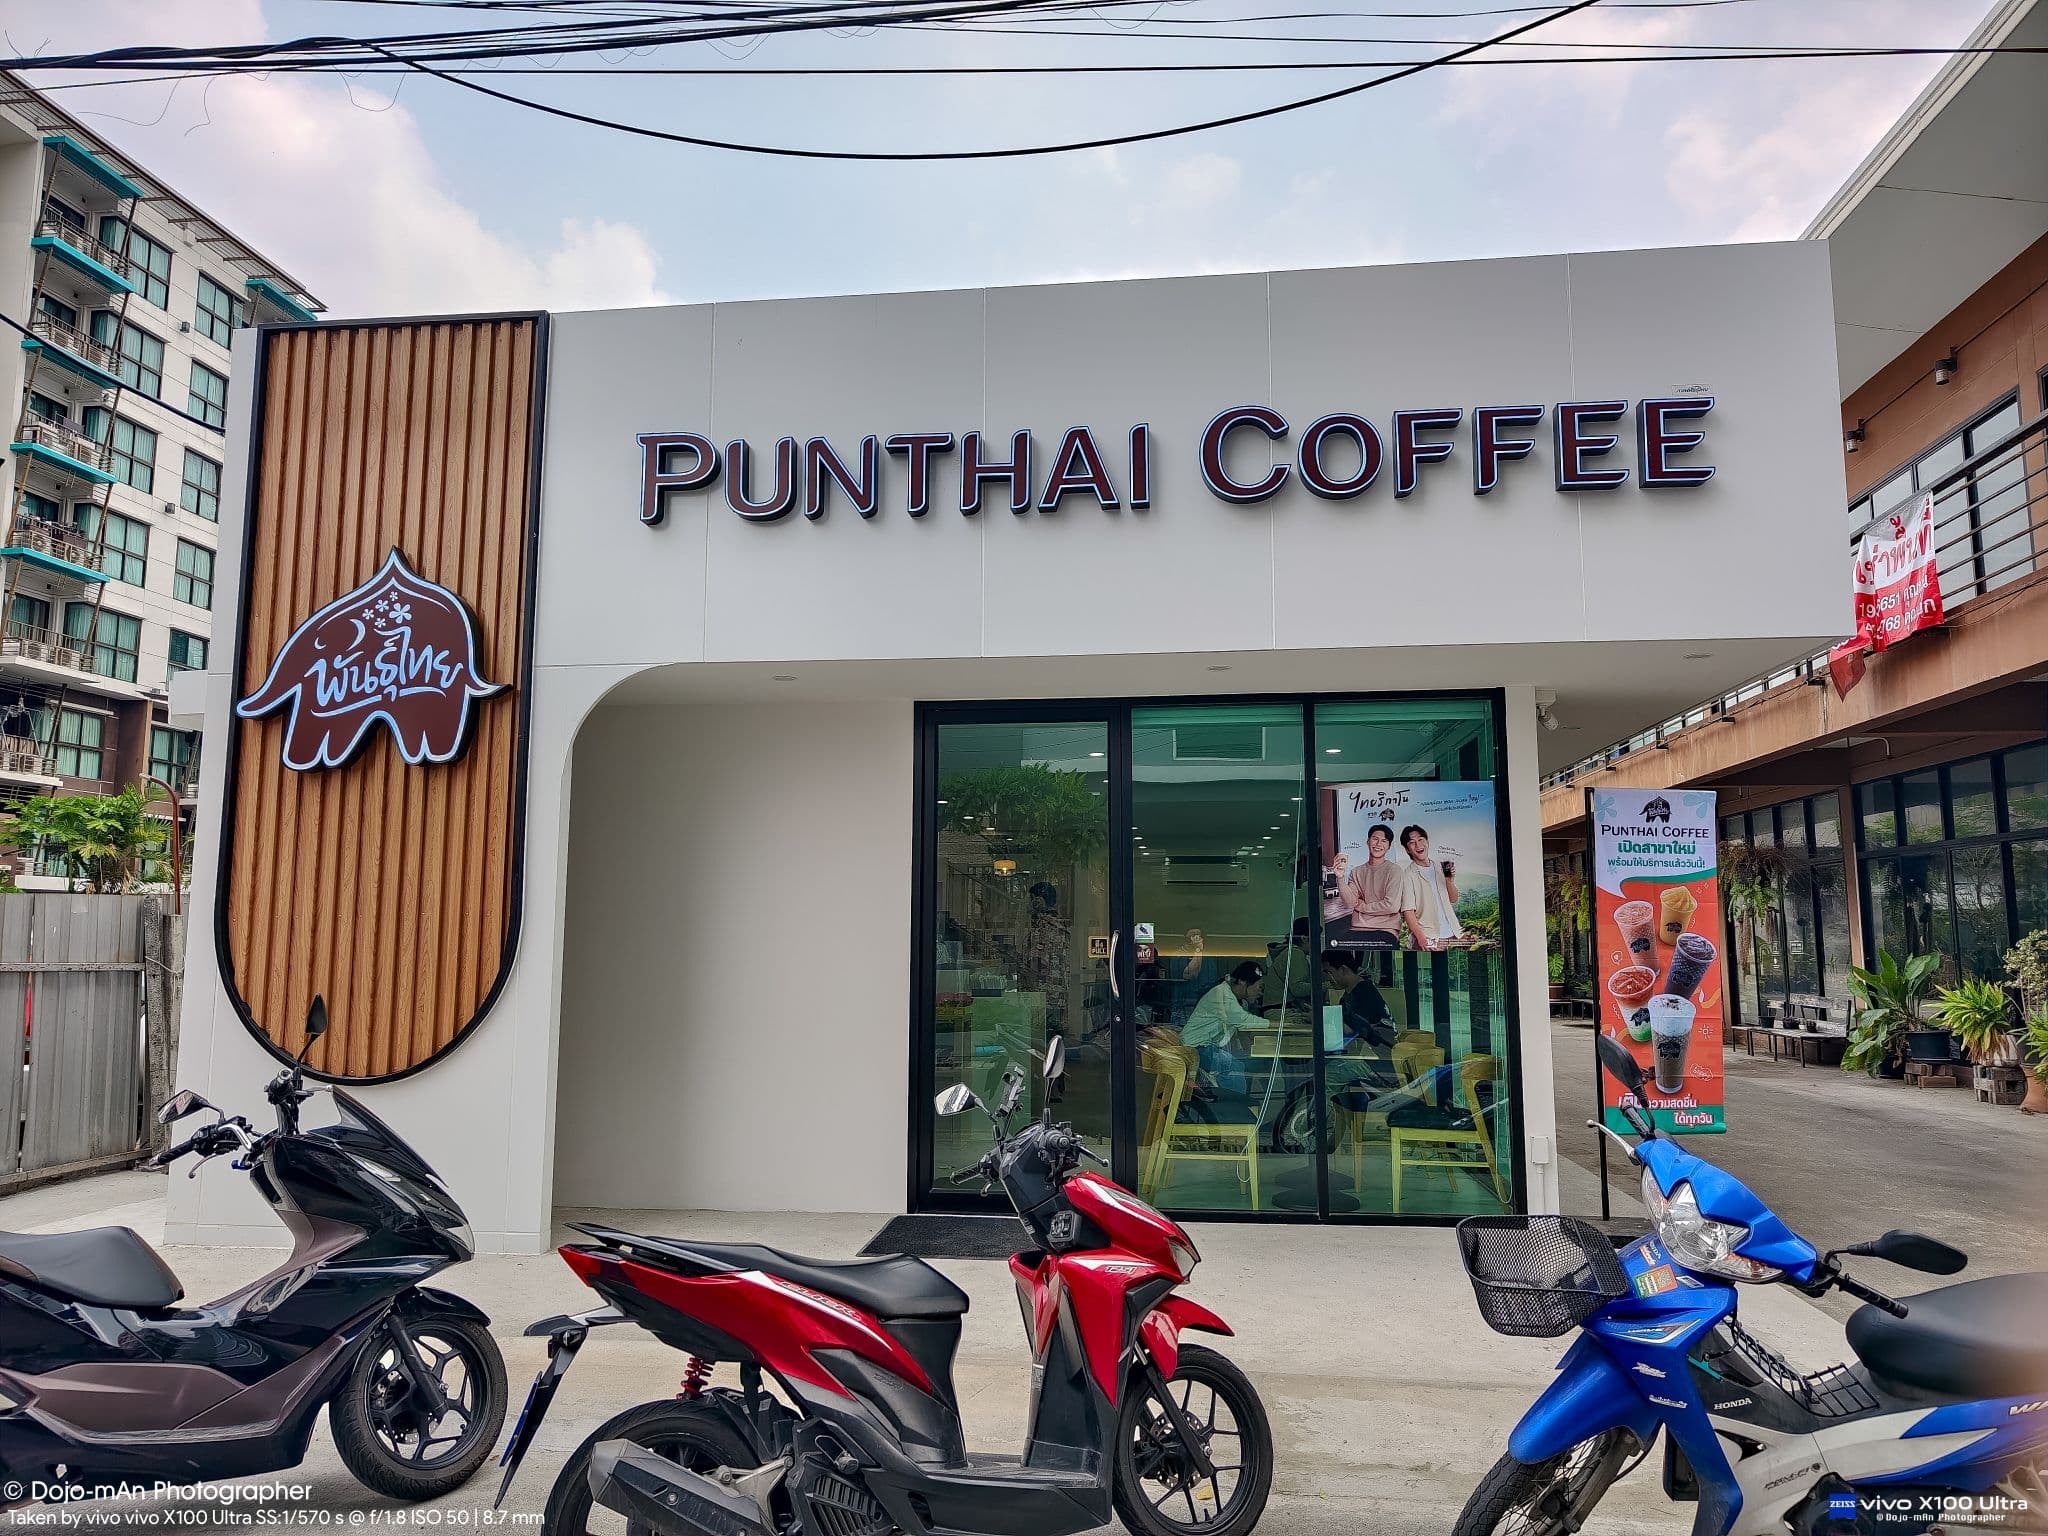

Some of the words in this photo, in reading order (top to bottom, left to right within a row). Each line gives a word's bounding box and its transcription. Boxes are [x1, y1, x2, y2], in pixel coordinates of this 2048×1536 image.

[636, 423, 1150, 526] PUNTHAI
[1199, 397, 1715, 504] COFFEE
[304, 626, 464, 706] พันธุ์ไทย
[1349, 789, 1411, 813] ไทยริกาโน
[1600, 824, 1658, 837] PUNTHAI
[1662, 826, 1710, 839] COFFEE
[1617, 840, 1696, 855] เปิดสาขาใหม่
[1674, 1111, 1713, 1128] ได้ทุกวัน
[1713, 1397, 1753, 1410] HONDA
